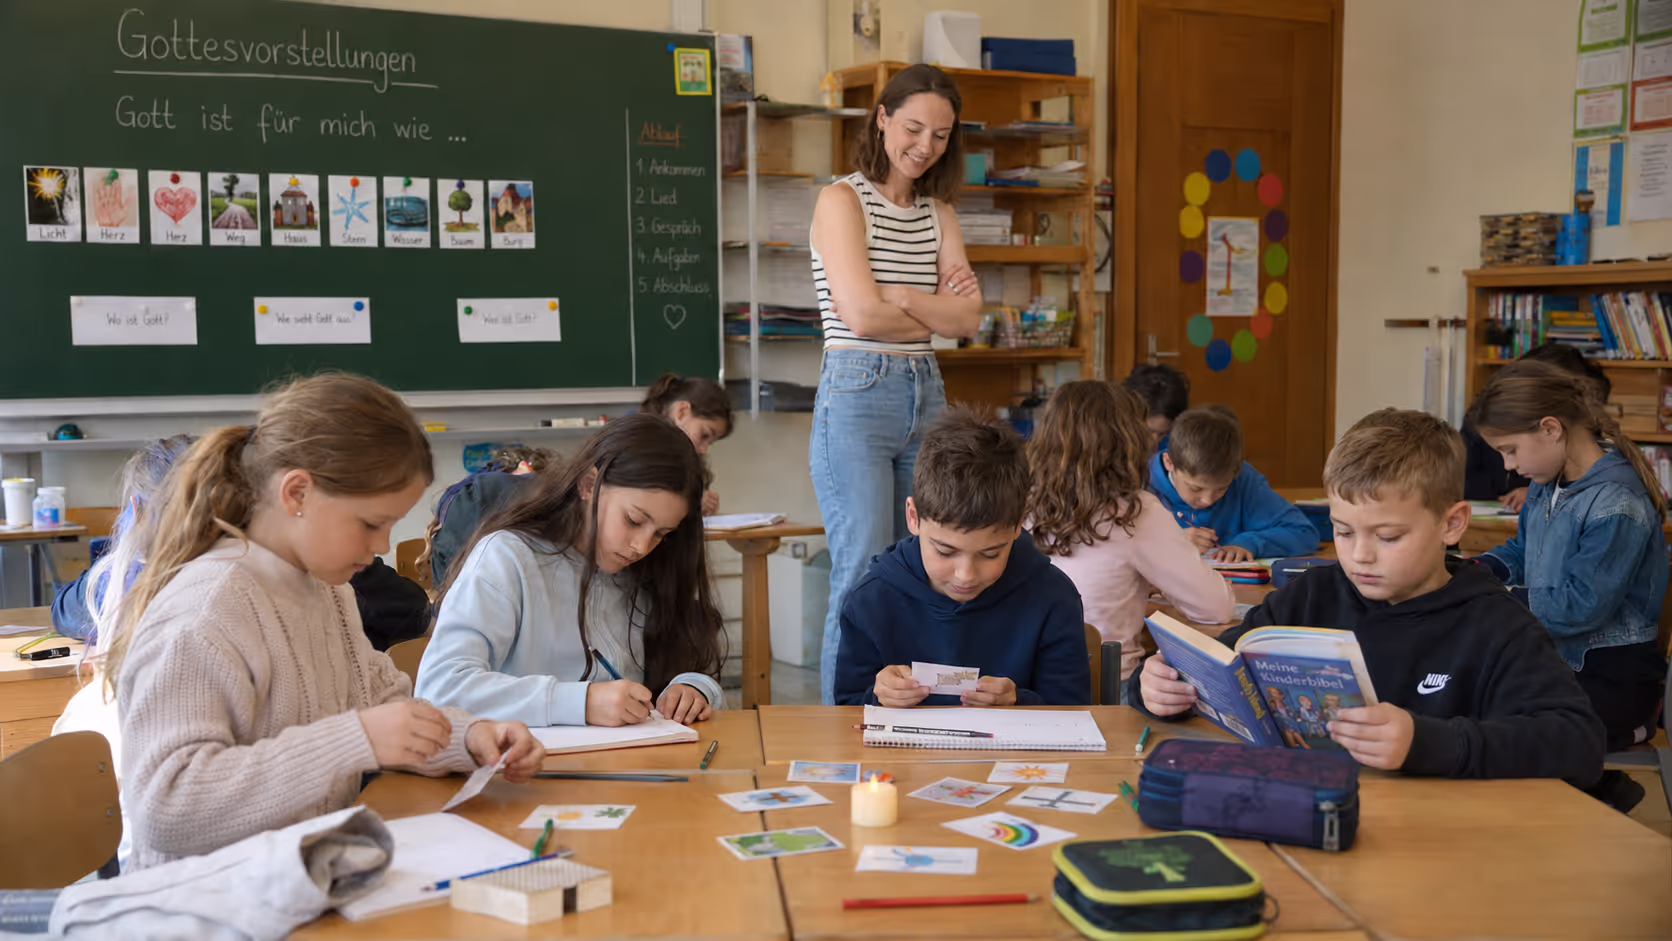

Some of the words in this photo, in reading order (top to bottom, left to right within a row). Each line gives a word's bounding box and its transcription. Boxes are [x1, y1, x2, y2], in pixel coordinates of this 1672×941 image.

[117, 8, 416, 93] Gottesvorstellungen
[115, 95, 177, 130] Gott
[201, 105, 234, 132] ist
[256, 103, 300, 144] für
[320, 110, 376, 139] mich
[394, 116, 433, 141] wie
[649, 158, 706, 177] Ankommen
[650, 187, 678, 205] Lied
[40, 227, 67, 239] Licht
[100, 229, 126, 241] Herz
[651, 216, 702, 240] Gespräch
[166, 230, 188, 242] Herz
[225, 231, 246, 244] Weg
[283, 232, 308, 243] Haus
[342, 233, 367, 244] Stern
[652, 246, 700, 271] Aufgaben
[106, 312, 122, 326] Wo
[126, 313, 139, 326] ist
[1255, 660, 1299, 674] Meine
[1260, 671, 1344, 690] Kinderbibel
[1424, 673, 1450, 687] NIKE
